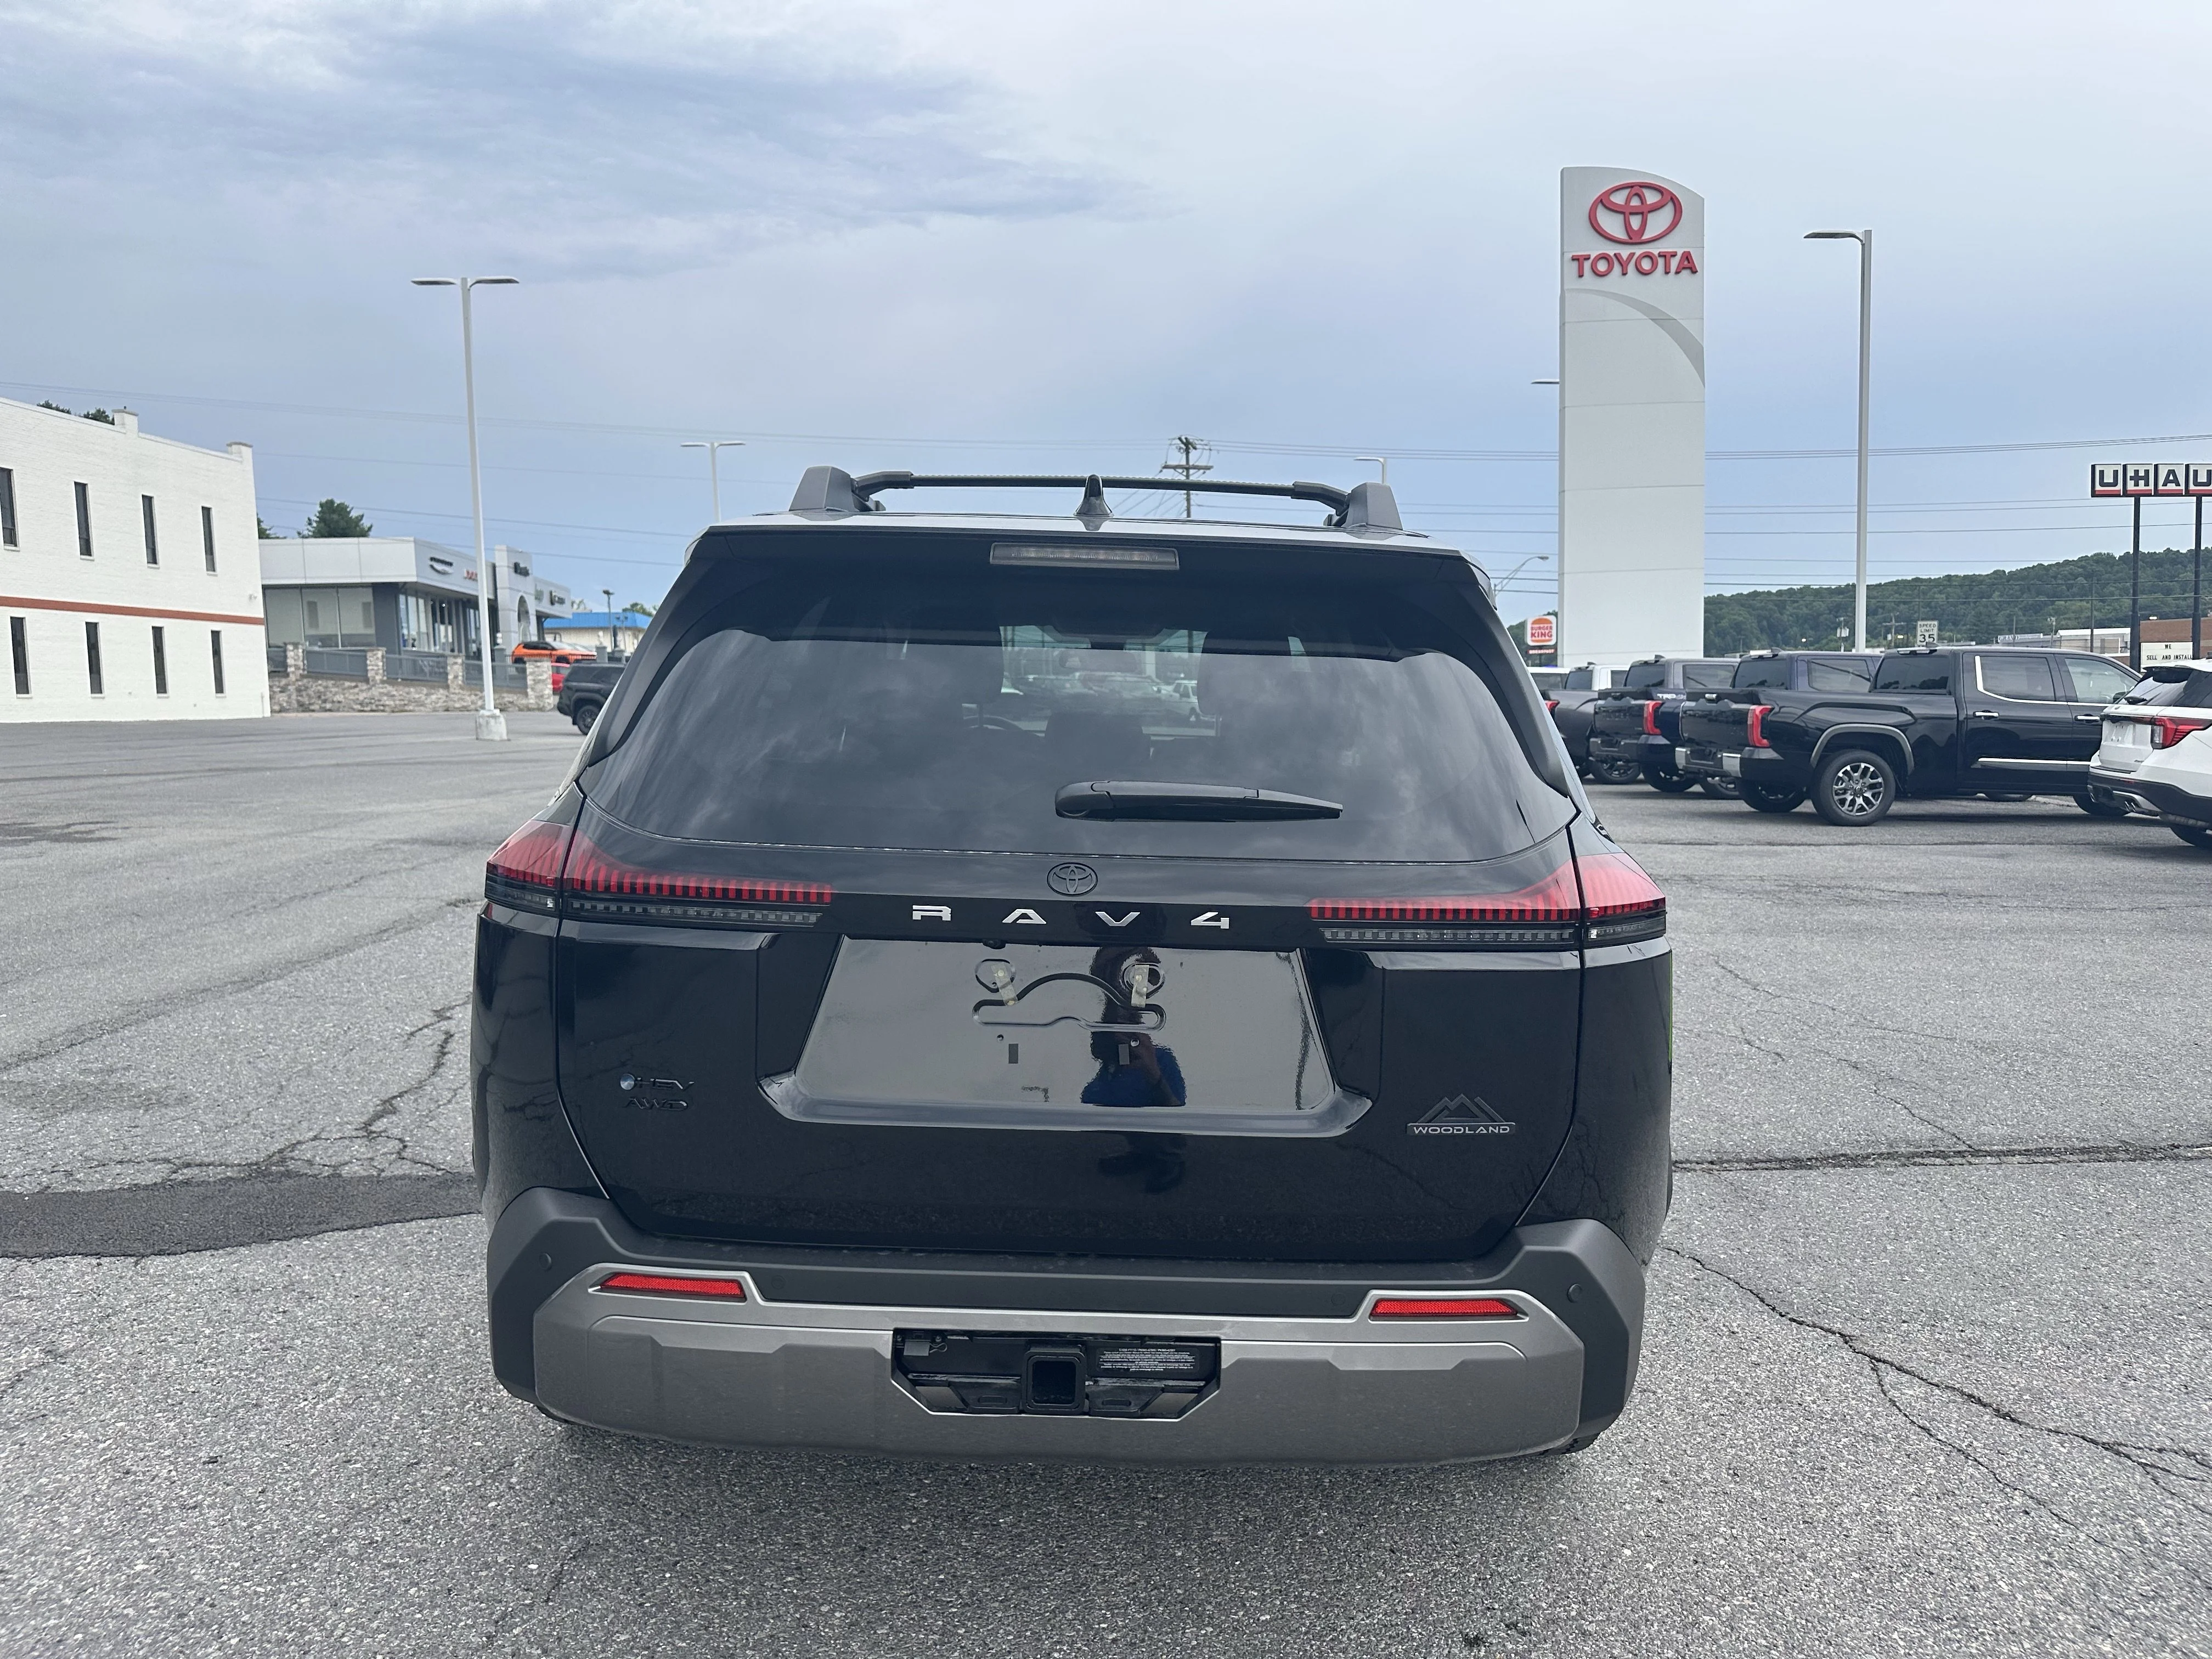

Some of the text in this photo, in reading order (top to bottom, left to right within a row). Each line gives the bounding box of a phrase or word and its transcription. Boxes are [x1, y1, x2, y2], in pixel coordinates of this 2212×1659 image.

[1571, 251, 1699, 278] TOYOTA
[1919, 634, 1936, 643] 35
[912, 905, 1230, 929] RAV4
[623, 1097, 688, 1111] AWD
[1413, 1126, 1510, 1134] WOODLAND
